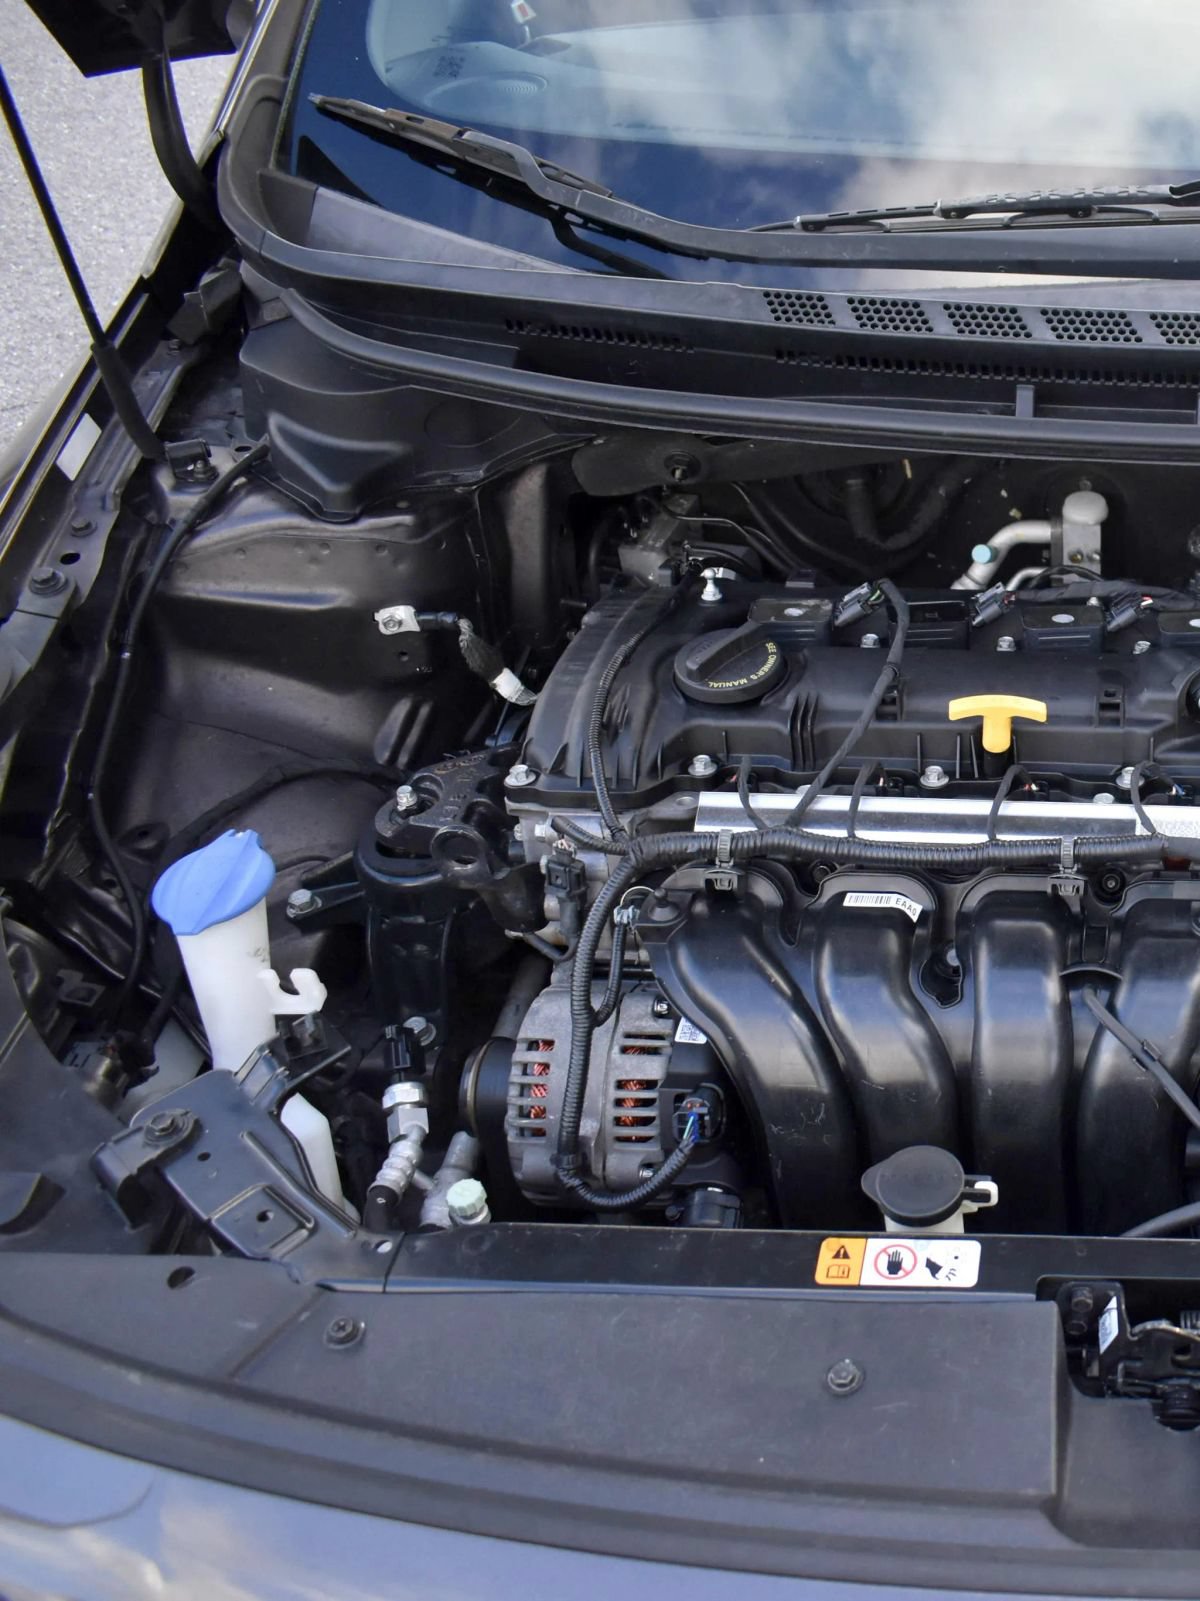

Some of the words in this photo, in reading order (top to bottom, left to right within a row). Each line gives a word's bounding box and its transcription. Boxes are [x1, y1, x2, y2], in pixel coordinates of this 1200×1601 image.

[766, 642, 777, 653] SEE
[750, 654, 777, 680] OWNER'S
[708, 678, 748, 688] MANUAL
